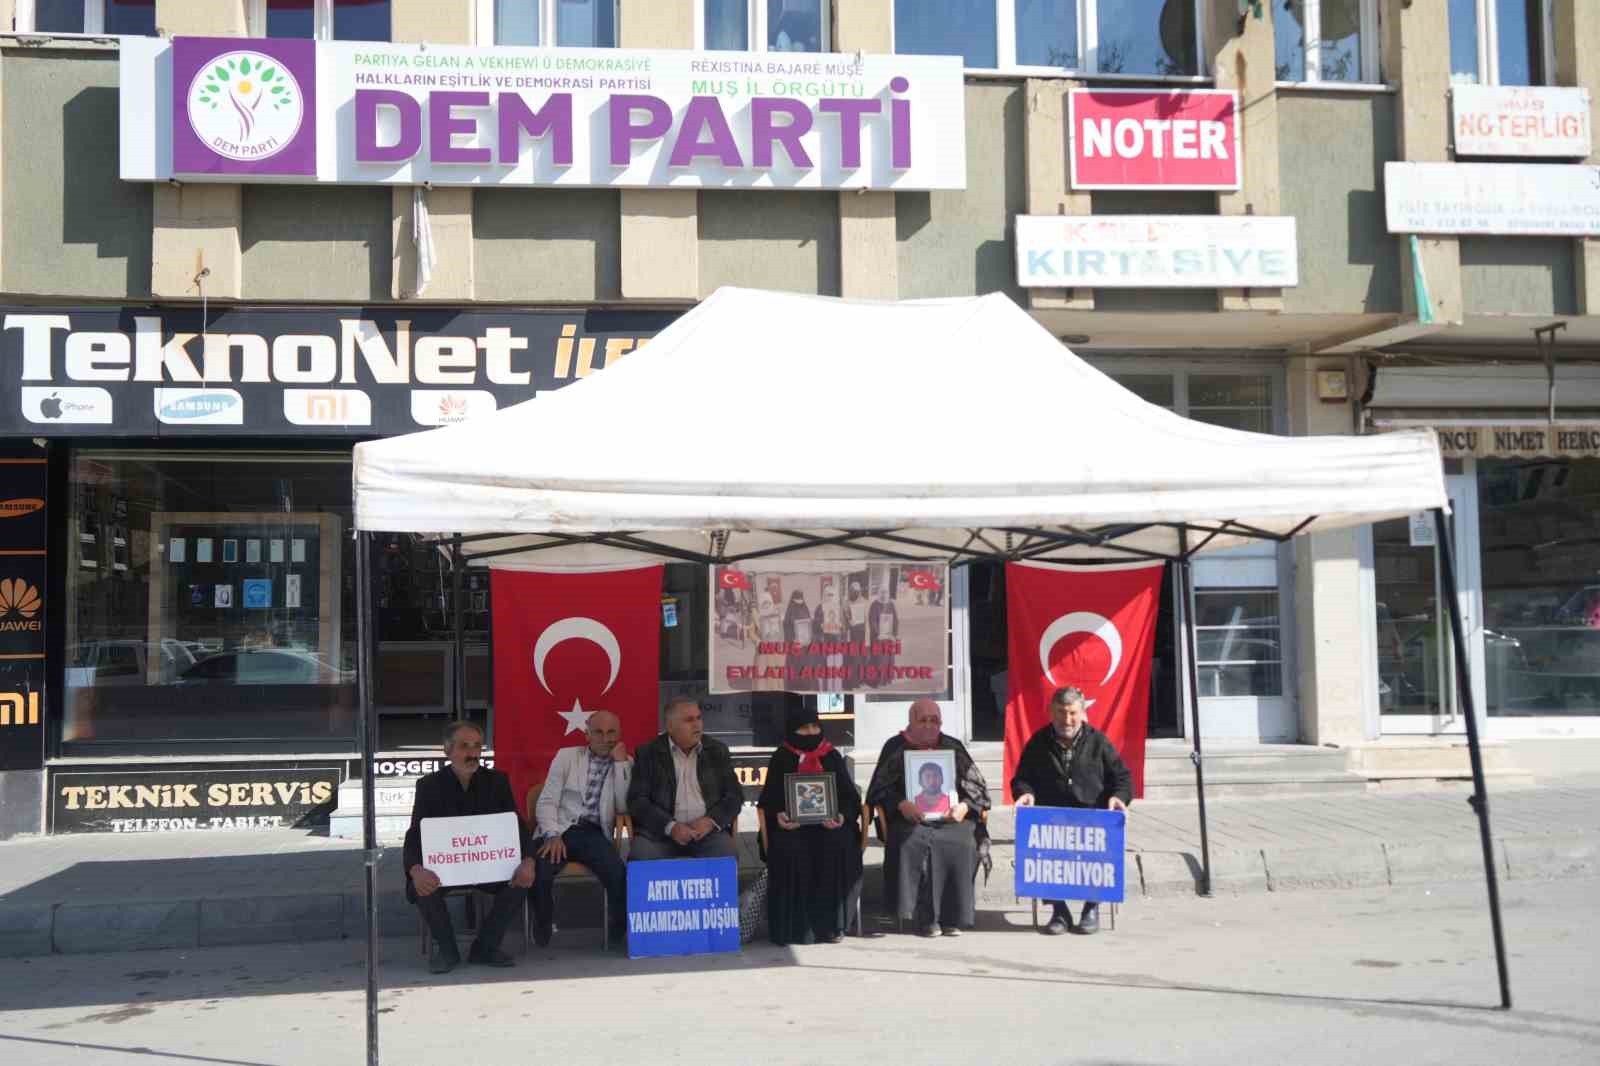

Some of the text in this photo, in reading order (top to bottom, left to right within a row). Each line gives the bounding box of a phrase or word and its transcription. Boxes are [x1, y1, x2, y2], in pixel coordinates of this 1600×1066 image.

[413, 54, 460, 68] GELAN
[464, 55, 474, 68] A
[355, 72, 437, 87] HALKLARIN
[439, 72, 491, 88] EŞİTLİK
[494, 76, 513, 88] VE
[515, 75, 594, 90] DEMOKRASİ
[691, 77, 865, 98] MUŞ İL ÖRGÜTÜ
[355, 76, 913, 170] DEM PARTİ
[213, 136, 240, 155] DEM
[1082, 117, 1229, 160] NOTER
[3, 313, 532, 385] TeknoNet
[758, 638, 902, 659] MUŞ ANNELERİ
[110, 817, 197, 833] TELEFON
[208, 814, 283, 832] TABLET
[452, 834, 489, 848] EVLAT
[1027, 823, 1107, 852] ANNELER
[428, 847, 516, 865] NÖBETİNDEYİZ
[1023, 852, 1116, 889] DİRENİYOR
[647, 879, 680, 902] ARTIK
[681, 877, 713, 900] YETER
[628, 901, 740, 936] YAKAMIZDAN DÜŞÜN
